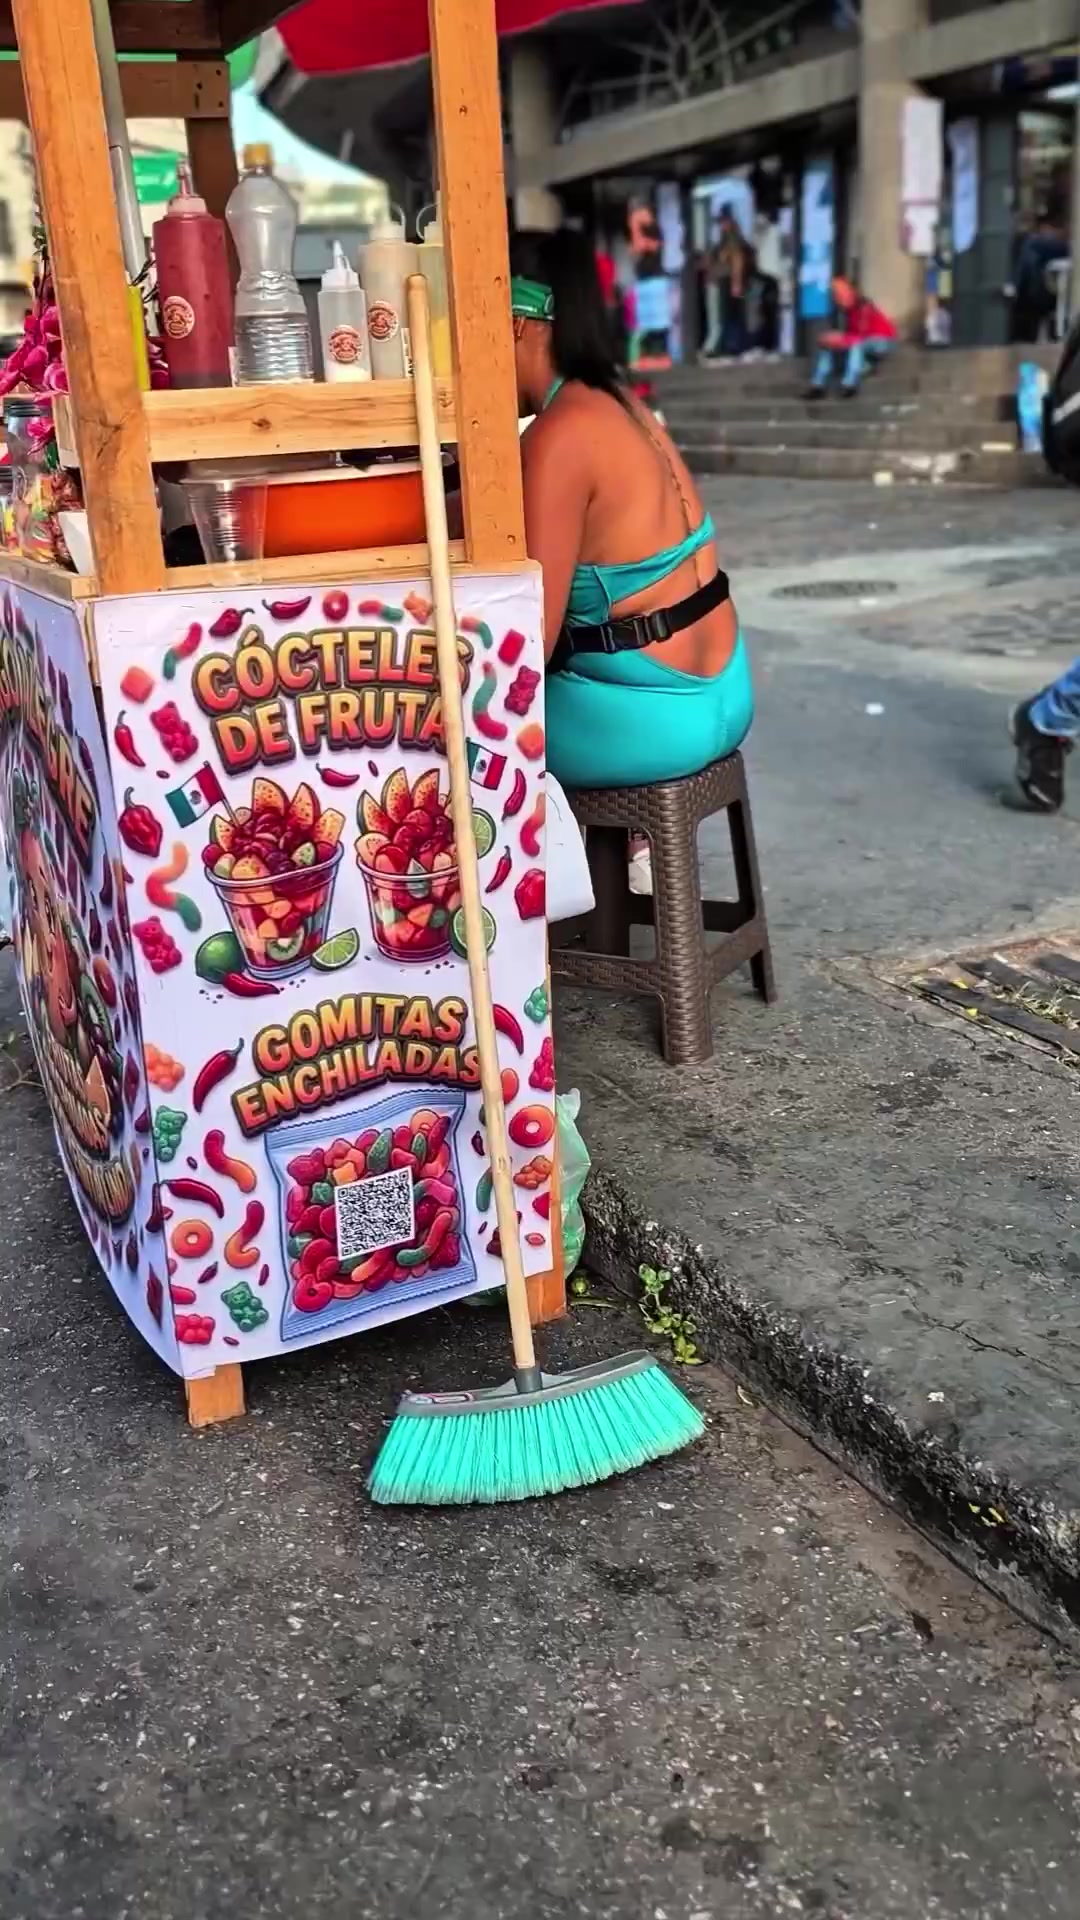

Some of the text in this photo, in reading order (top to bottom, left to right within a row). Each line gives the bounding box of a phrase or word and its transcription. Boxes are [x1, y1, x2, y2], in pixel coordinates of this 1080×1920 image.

[213, 702, 294, 774] DE
[255, 994, 467, 1077] GOMITAS
[234, 1040, 482, 1135] ENCHILADAS
